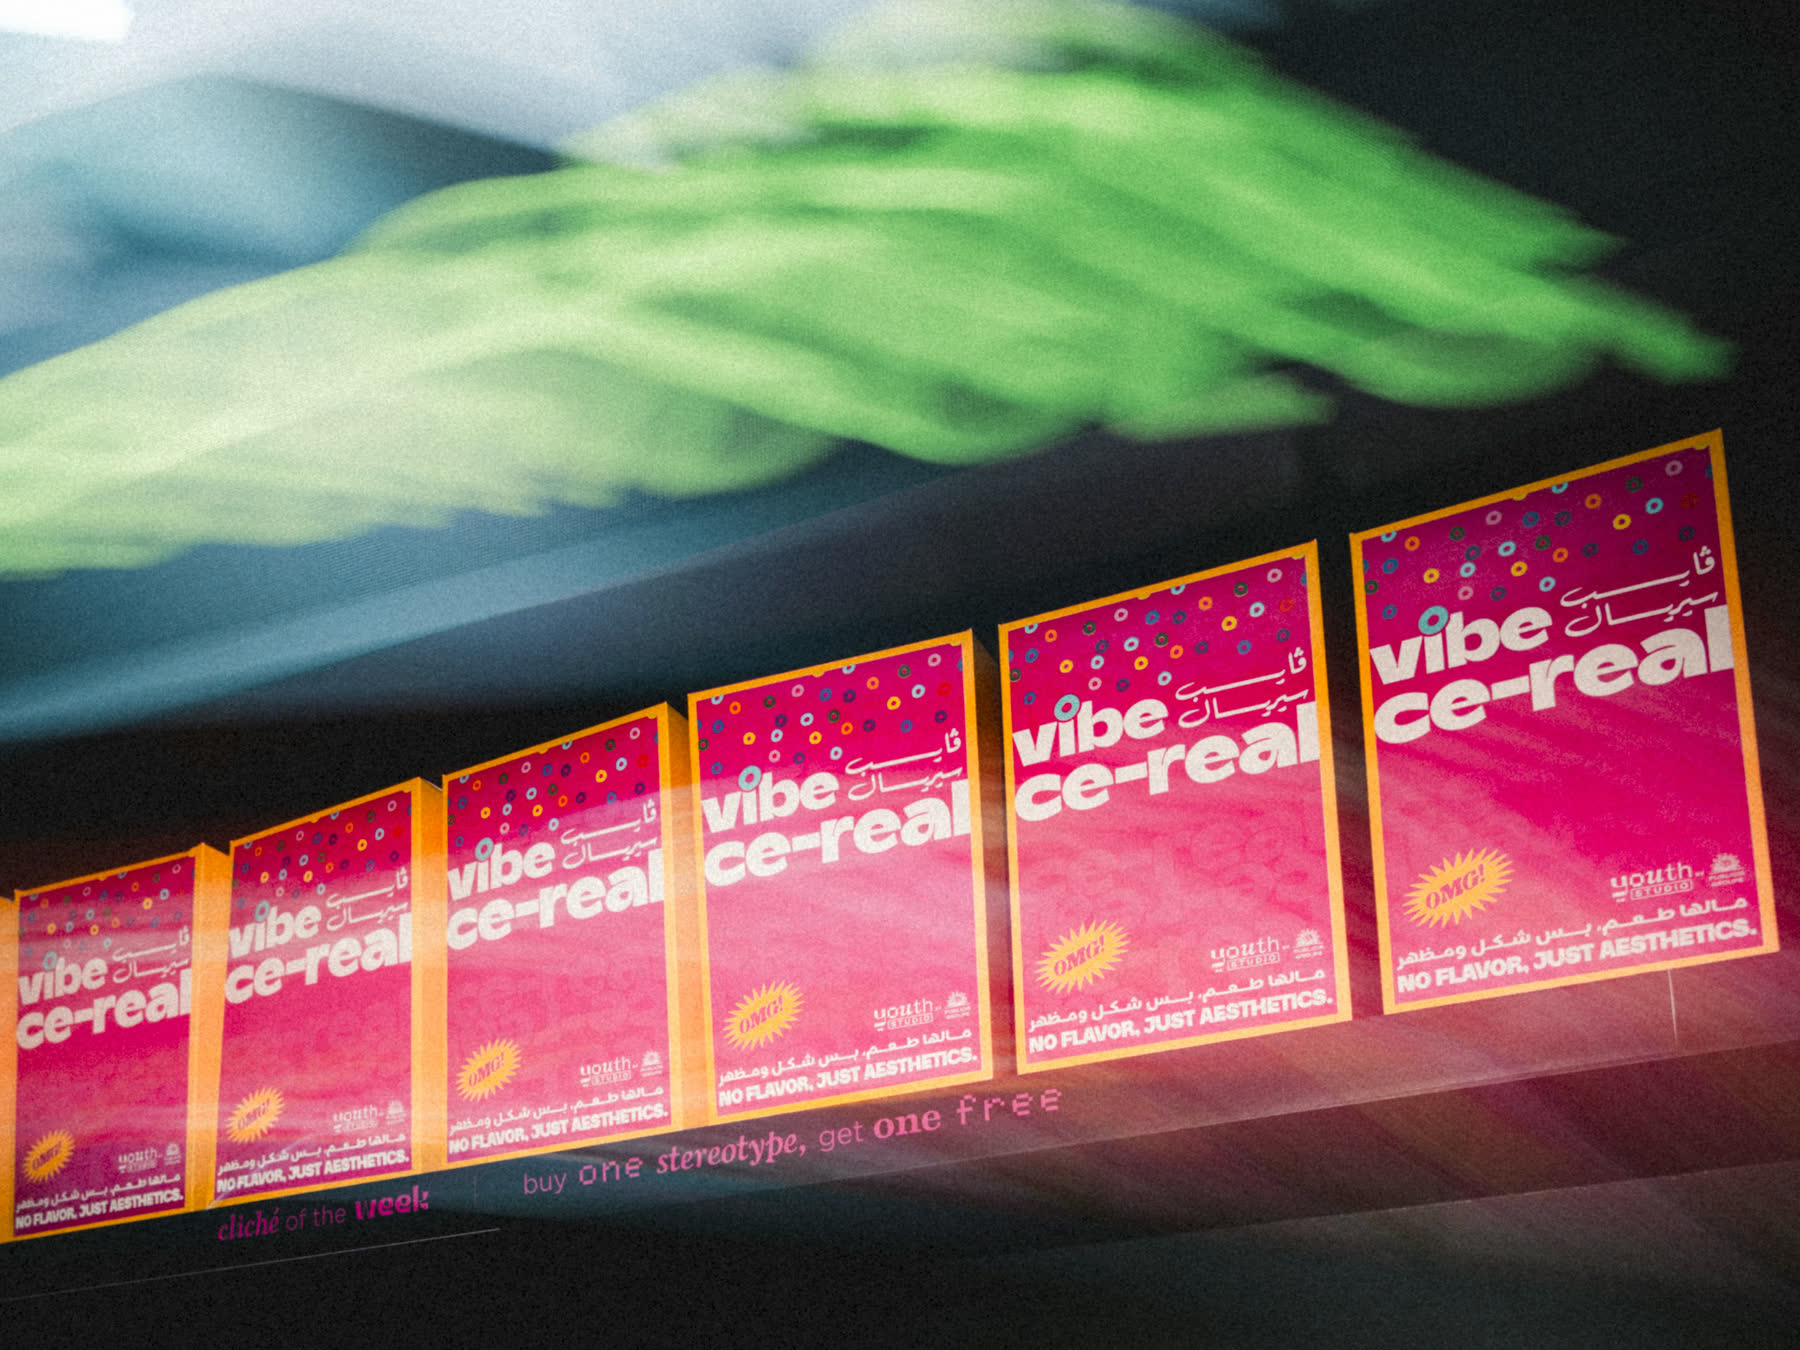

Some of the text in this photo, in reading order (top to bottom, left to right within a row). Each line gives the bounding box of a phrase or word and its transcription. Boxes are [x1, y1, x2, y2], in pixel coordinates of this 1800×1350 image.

[1368, 605, 1552, 684] vibe
[1373, 604, 1732, 743] ce-real
[1011, 694, 1167, 766] vibe
[1013, 702, 1318, 821] ce-real
[700, 765, 838, 833] vibe
[702, 780, 968, 886] ce-real
[443, 848, 662, 949] ce-real
[445, 837, 554, 900] vibe
[1425, 863, 1485, 909] OMG!
[1609, 862, 1693, 903] youth
[1633, 879, 1691, 899] STUDIO
[224, 912, 410, 1004] ce-real
[228, 899, 321, 958] vibe
[1053, 934, 1105, 976] OMG!
[1209, 936, 1280, 973] youth
[1397, 918, 1756, 992] NO FLAVOR, JUST AESTHETICS.
[16, 950, 107, 1005] vibe
[15, 969, 190, 1049] ce-real
[739, 994, 783, 1034] OMG!
[873, 997, 933, 1032] youth
[1028, 988, 1332, 1052] NO FLAVOR, JUST AESTHETICS.
[718, 1088, 743, 1106] NO
[816, 1066, 860, 1088] JUST
[863, 1046, 976, 1080] AESTHETICS.
[448, 1137, 469, 1153] NO
[531, 1118, 568, 1138] JUST
[523, 1088, 1062, 1195] buy one stereotype, get one free
[217, 1177, 235, 1192] NO
[288, 1161, 322, 1179] JUST
[217, 1185, 429, 1241] cliché of the week
